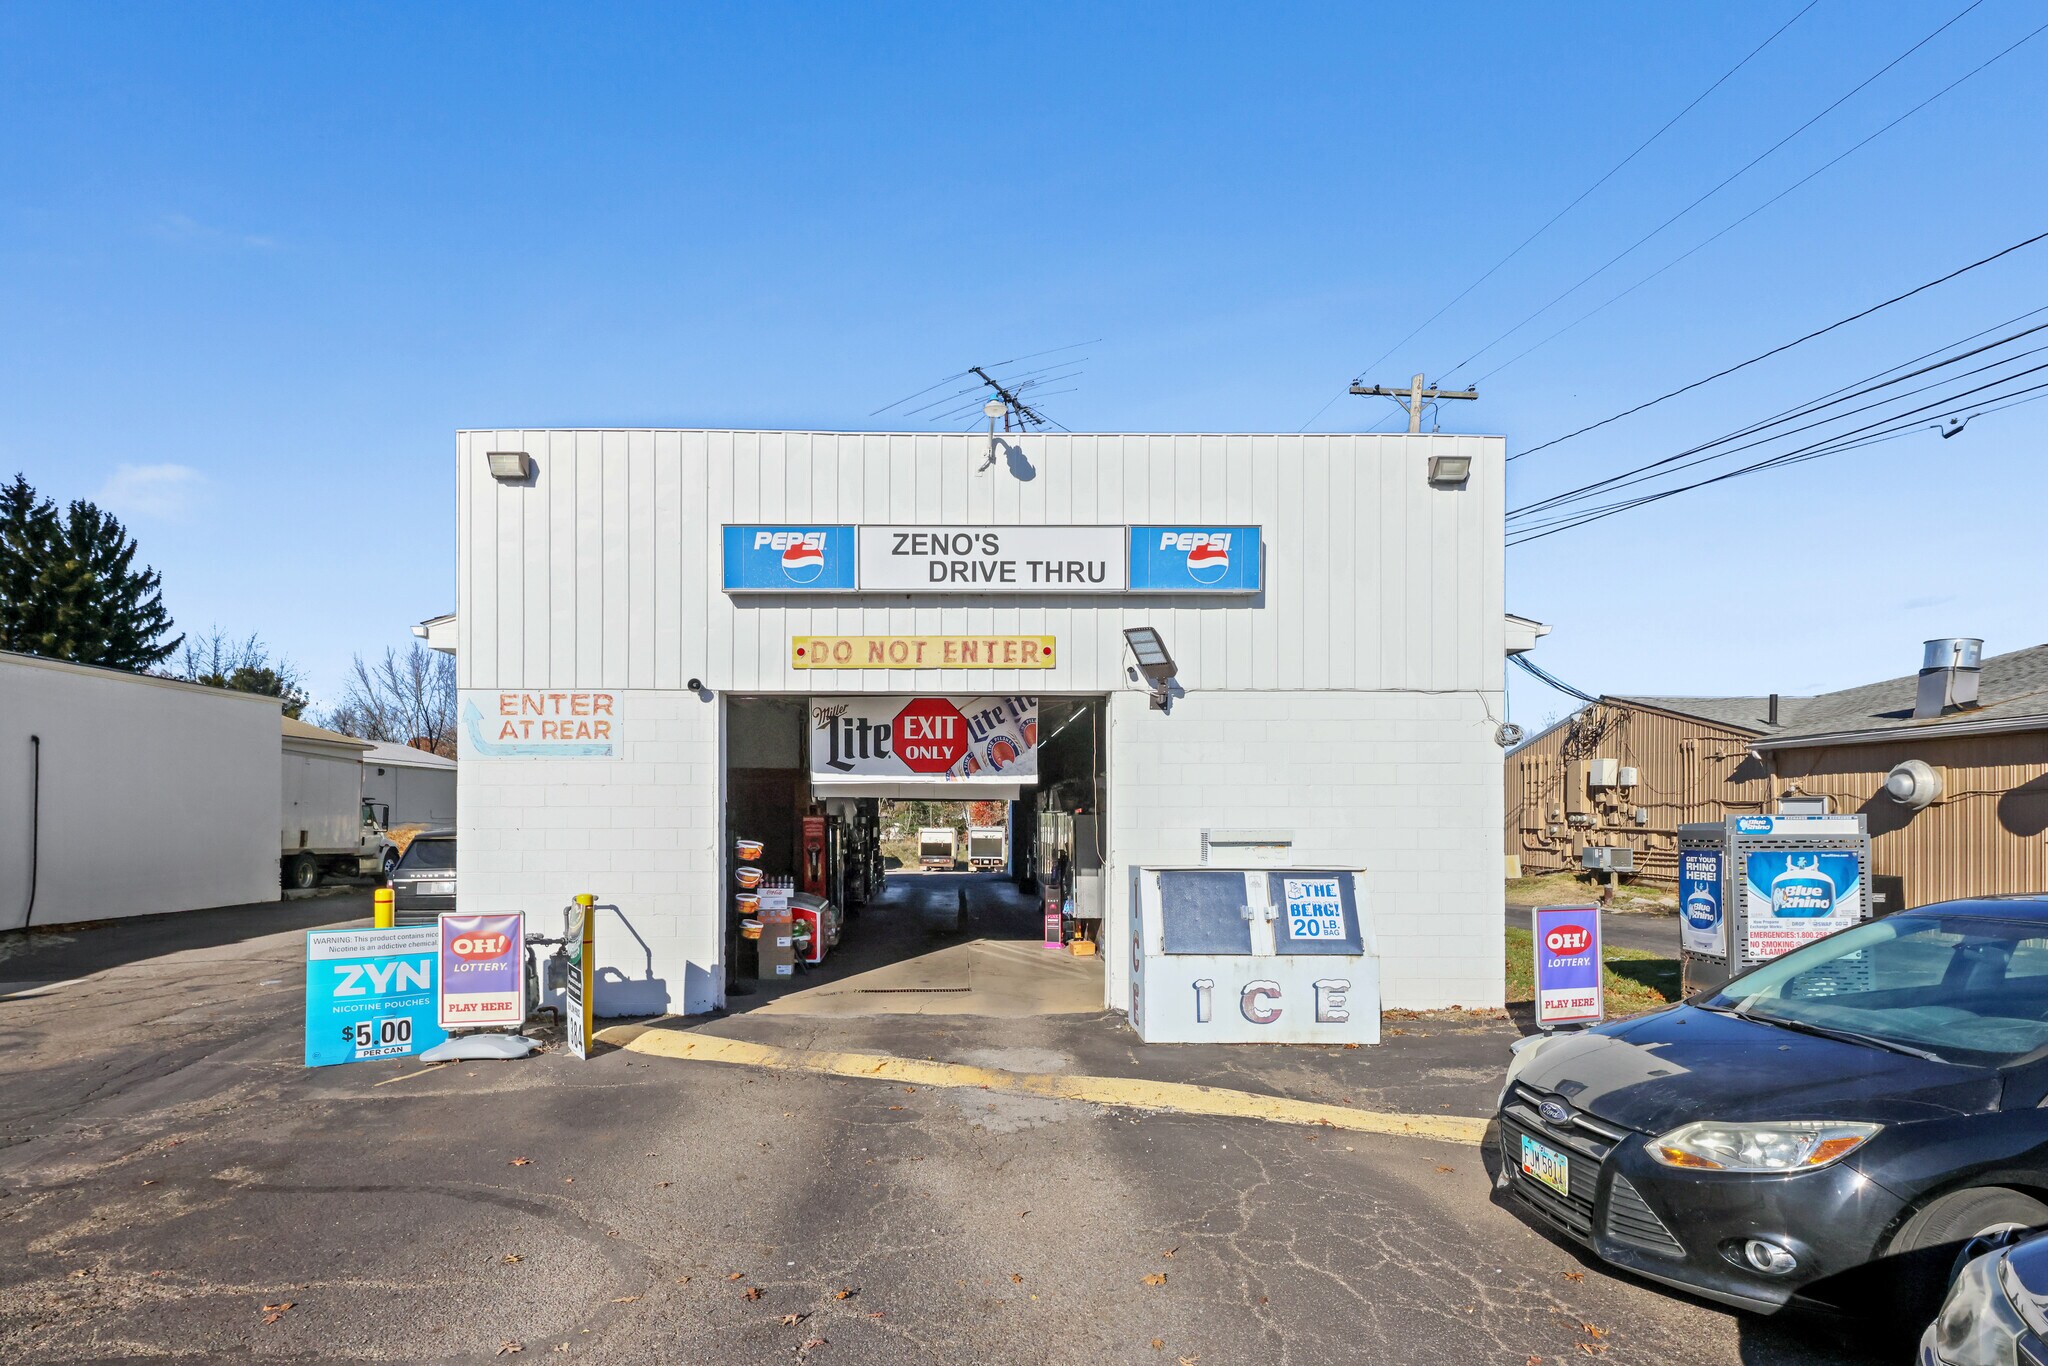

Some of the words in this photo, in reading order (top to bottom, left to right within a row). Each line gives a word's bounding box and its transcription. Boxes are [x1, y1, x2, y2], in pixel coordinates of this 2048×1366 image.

[753, 531, 826, 552] PEPSI
[891, 532, 1000, 557] ZENO'S
[1159, 531, 1232, 552] PEPSI
[928, 560, 1017, 583] DRIVE
[1026, 560, 1106, 583] THRU
[810, 639, 853, 664] DO
[868, 639, 927, 664] NOT
[943, 639, 1040, 664] ENTER
[499, 693, 614, 717] ENTER
[813, 704, 849, 727] Miller
[498, 719, 535, 740] AT
[541, 719, 612, 740] REAR
[903, 715, 958, 740] EXIT
[826, 716, 891, 772] Lite
[905, 745, 954, 760] ONLY
[1686, 862, 1716, 872] RHINO
[1686, 872, 1717, 881] HERE!
[1302, 883, 1337, 897] THE
[1786, 886, 1823, 896] Blue
[1290, 901, 1340, 917] BERG!
[1694, 903, 1711, 911] Blue
[1782, 896, 1830, 909] Rhino
[1692, 910, 1714, 921] Rhino
[1294, 919, 1320, 936] 20
[1322, 920, 1340, 929] LB.
[313, 936, 353, 945] WARNING:
[369, 934, 397, 944] product
[397, 933, 425, 941] contains
[328, 945, 358, 953] Nicotine
[377, 941, 407, 950] addictive
[453, 935, 506, 955] OH!
[1547, 929, 1588, 950] OH!
[1761, 940, 1795, 948] SMOKING
[333, 959, 431, 998] ZYN
[332, 1002, 382, 1014] NICOTINE
[384, 997, 431, 1009] POUCHES
[448, 1002, 479, 1013] PLAY
[480, 1001, 513, 1012] HERE
[1192, 978, 1351, 1025] ICE
[1545, 999, 1569, 1009] PLAY
[1571, 997, 1595, 1008] HERE
[341, 1017, 412, 1048] $5.00
[363, 1048, 382, 1057] PER
[384, 1046, 404, 1055] CAN
[1542, 1104, 1560, 1119] Ford
